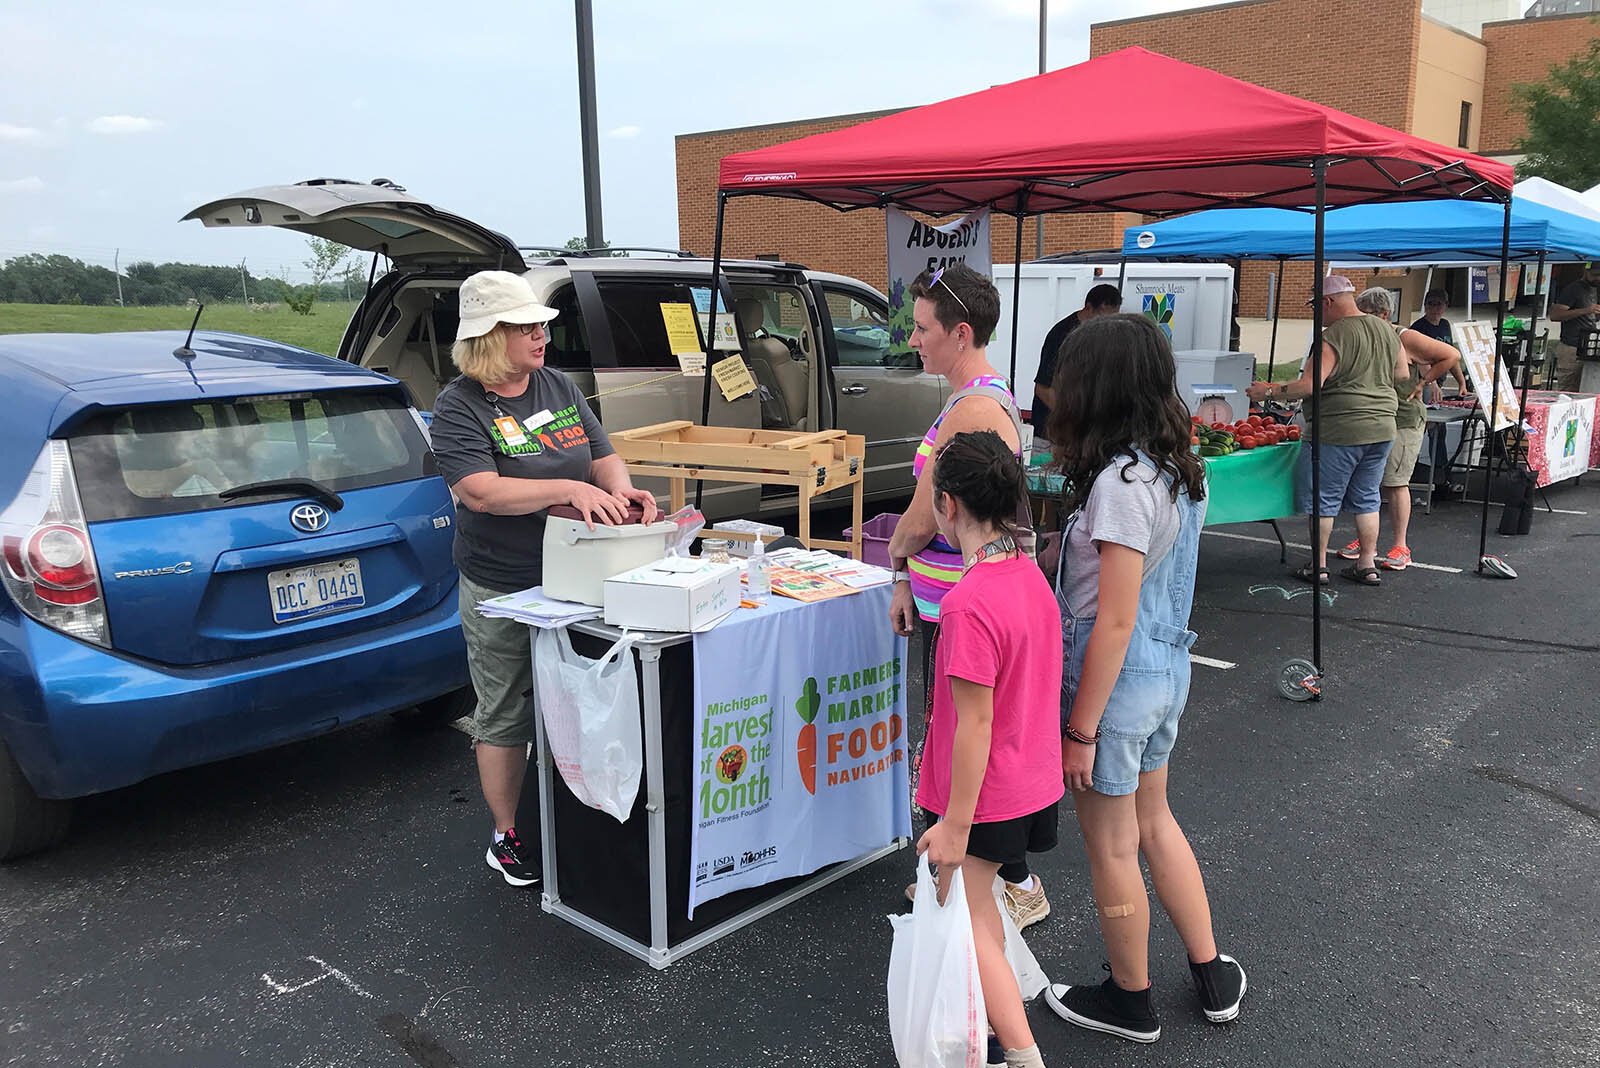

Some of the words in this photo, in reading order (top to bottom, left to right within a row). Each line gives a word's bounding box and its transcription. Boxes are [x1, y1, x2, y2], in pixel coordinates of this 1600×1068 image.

[548, 415, 581, 431] MARKE
[554, 426, 584, 442] FOO
[276, 582, 308, 610] DCC
[318, 572, 358, 601] 0449
[827, 657, 901, 695] FARMERS
[707, 694, 768, 717] Michigan
[828, 683, 901, 724] MARKET
[827, 713, 903, 764] FOOD
[751, 740, 771, 763] the
[828, 749, 903, 787] NAVIGATOR
[716, 812, 740, 824] Fitness
[713, 856, 735, 867] USDA
